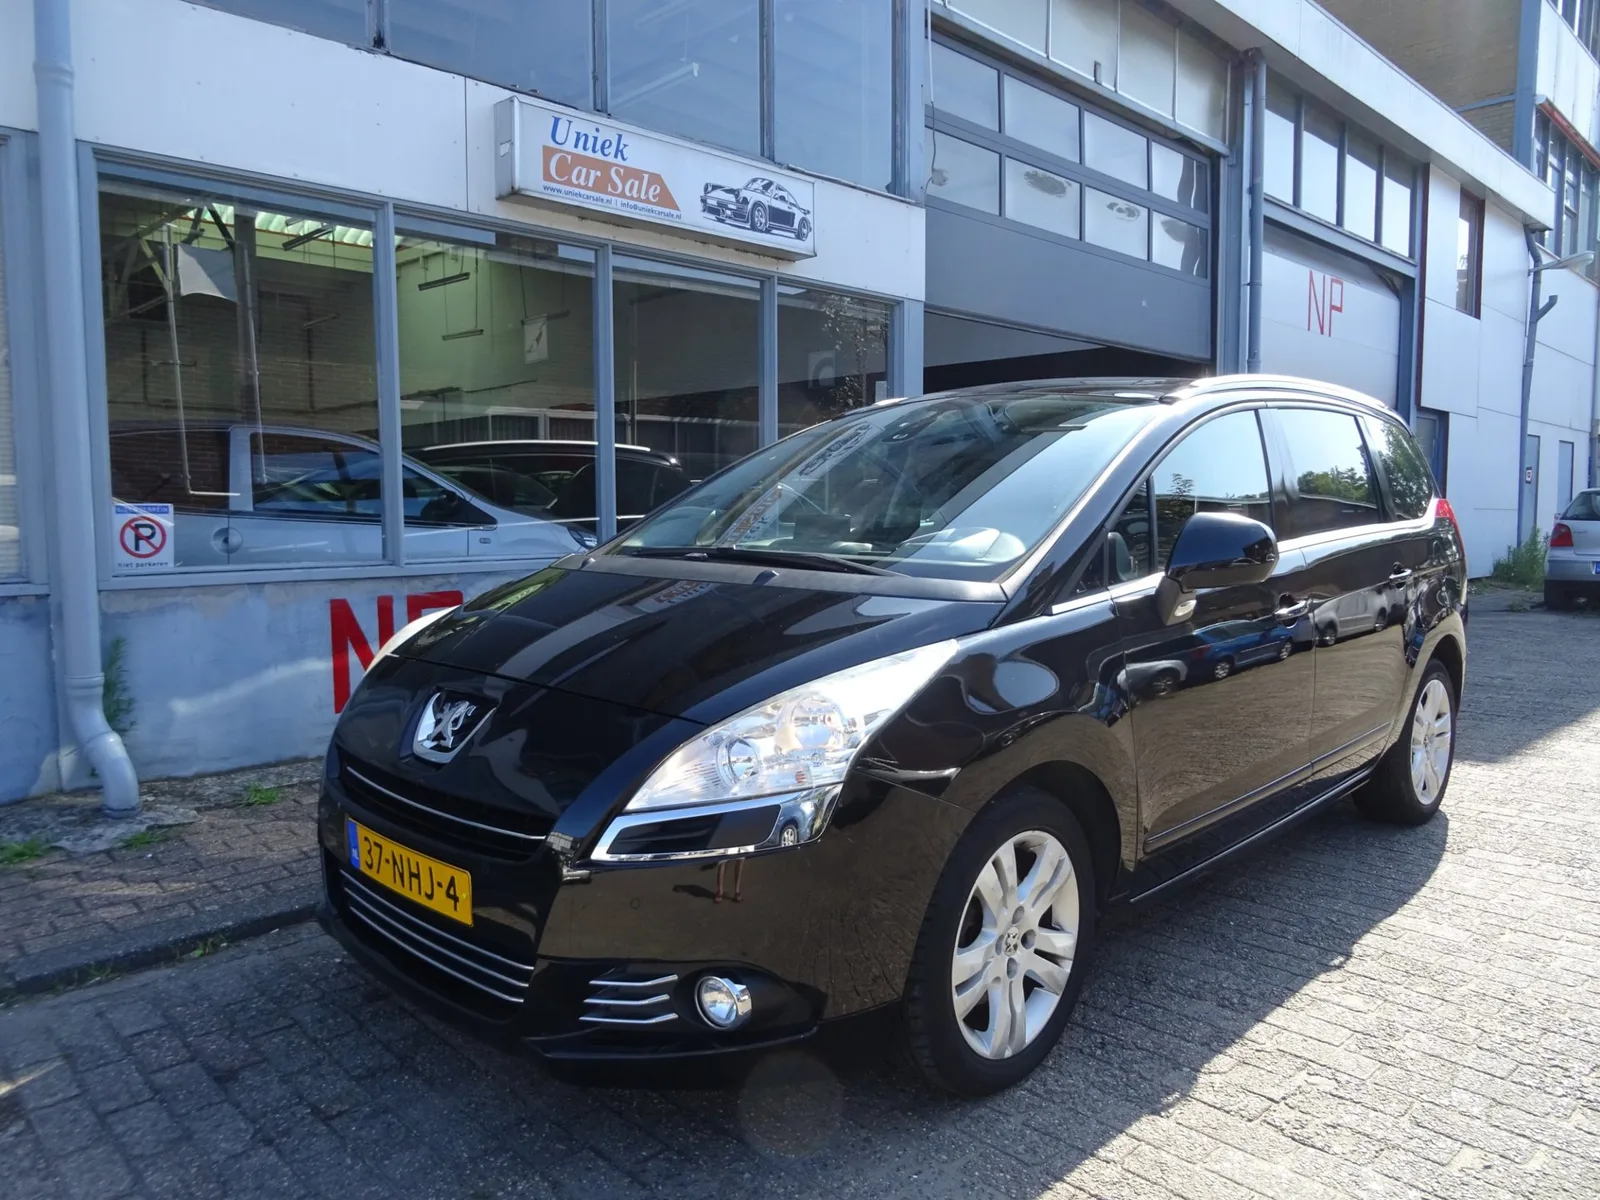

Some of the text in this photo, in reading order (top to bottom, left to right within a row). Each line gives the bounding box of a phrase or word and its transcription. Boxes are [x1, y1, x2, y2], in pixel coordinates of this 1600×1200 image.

[551, 116, 628, 161] Uniek
[542, 184, 682, 220] www.uniekcarsale.nl info@uniekcarsale.nl
[549, 152, 661, 203] Car Sale
[1307, 269, 1344, 338] NP
[363, 835, 460, 912] 37-NHJ-4
